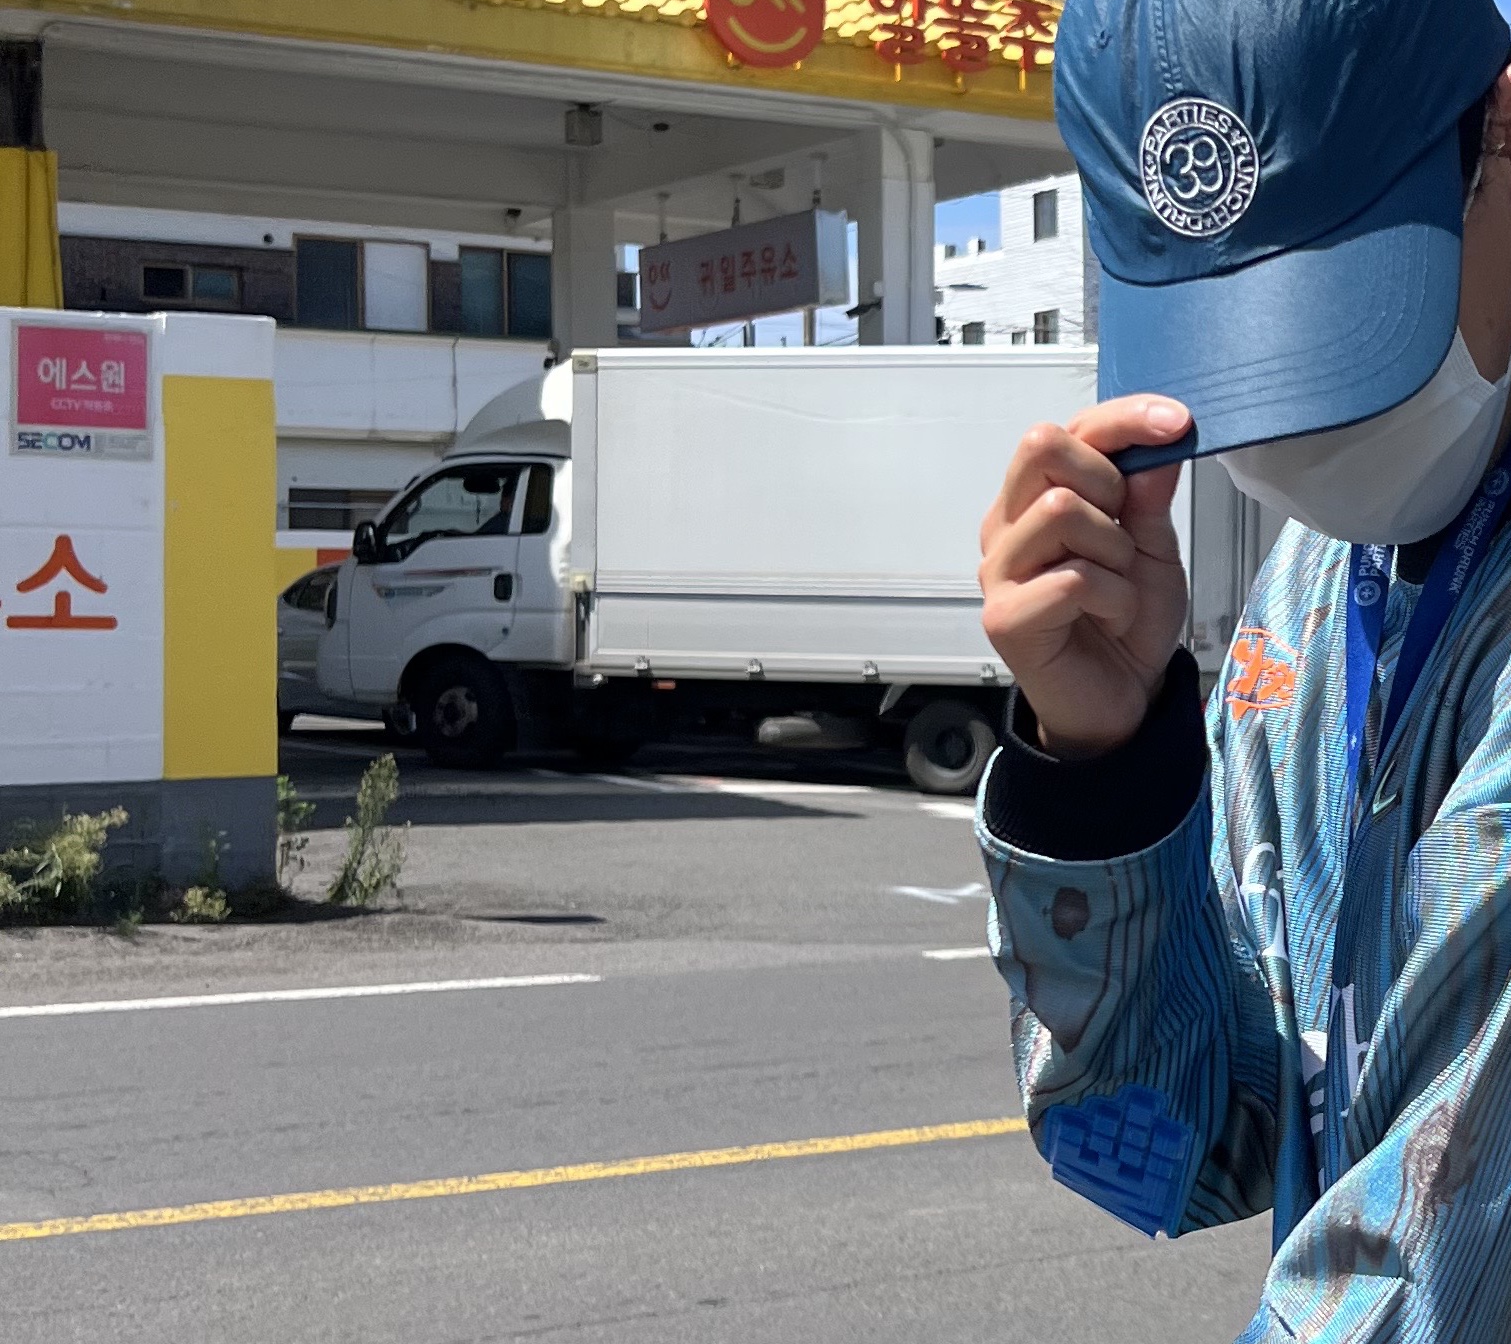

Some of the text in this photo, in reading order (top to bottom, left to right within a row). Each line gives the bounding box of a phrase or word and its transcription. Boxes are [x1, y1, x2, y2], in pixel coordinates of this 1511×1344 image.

[1144, 104, 1255, 231] PUNCH DRUNK PARTIES
[37, 357, 125, 394] 에스원
[18, 431, 92, 452] SECOM
[1358, 543, 1374, 576] PUNC
[0, 534, 118, 630] 소
